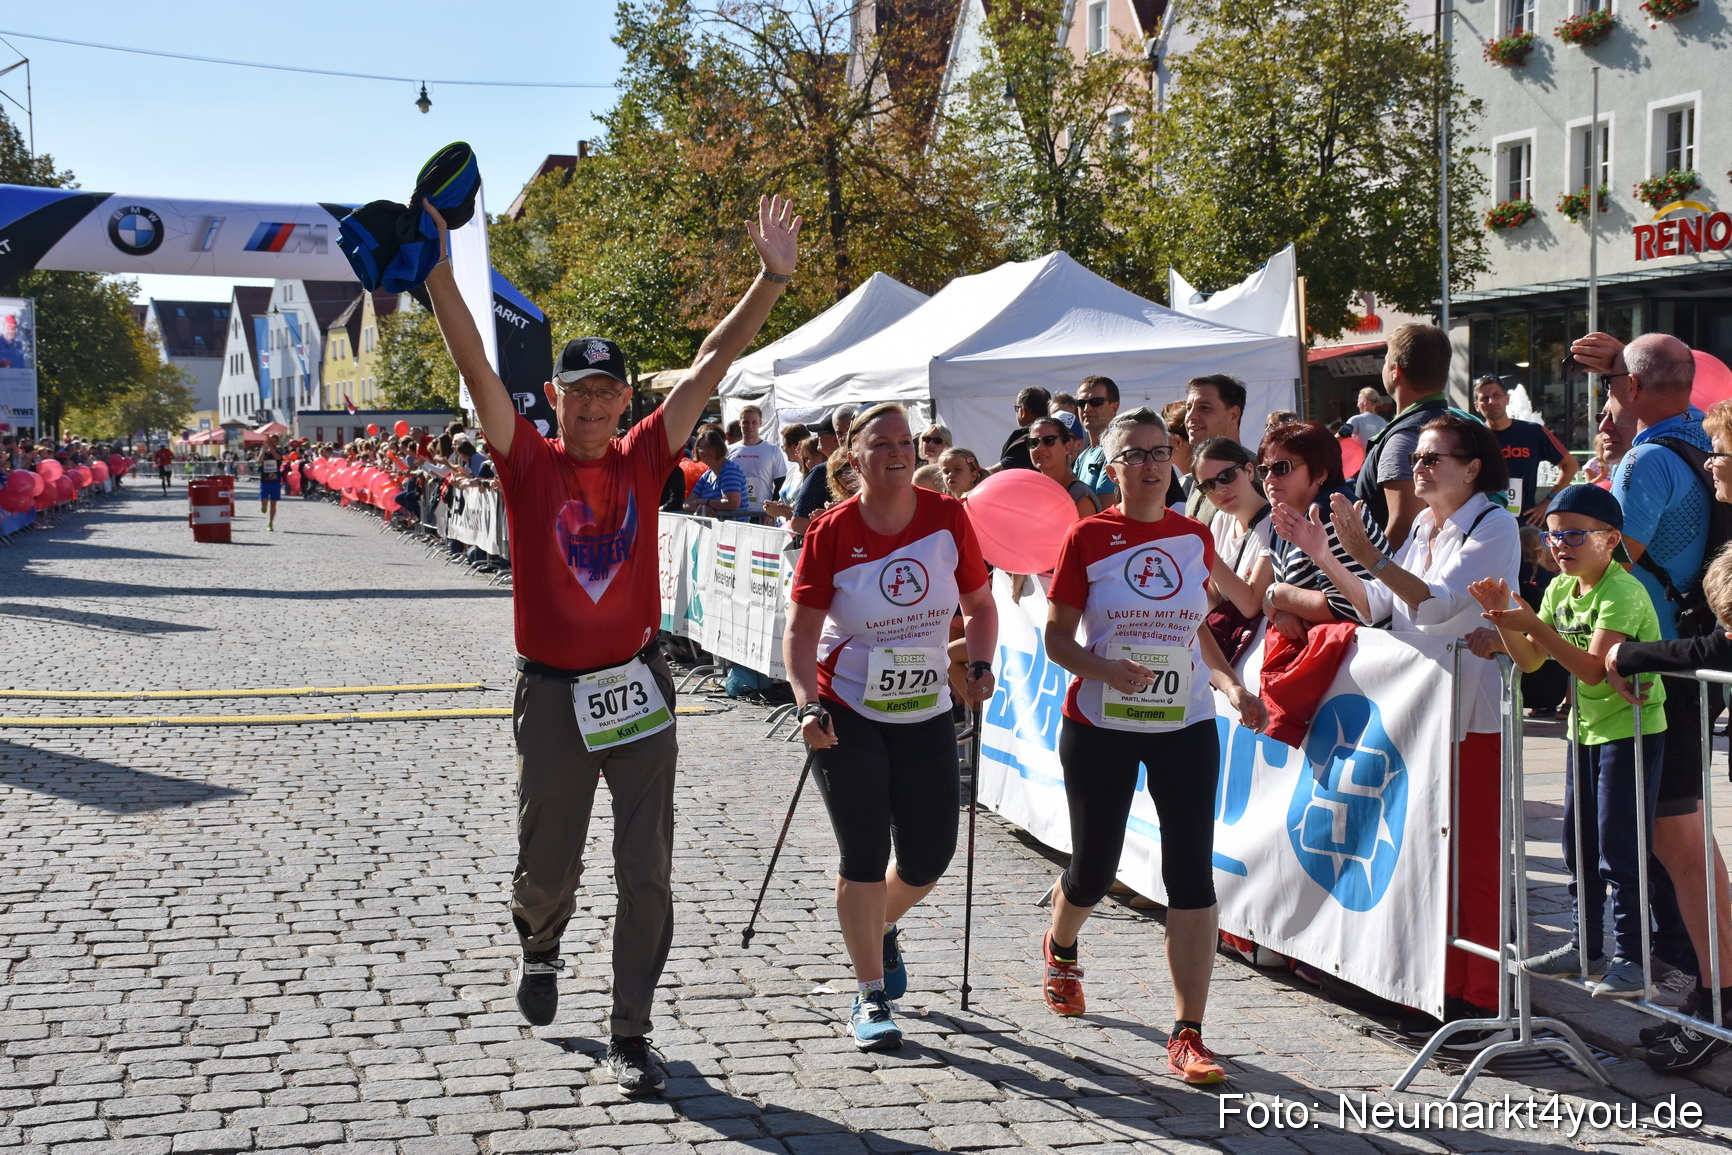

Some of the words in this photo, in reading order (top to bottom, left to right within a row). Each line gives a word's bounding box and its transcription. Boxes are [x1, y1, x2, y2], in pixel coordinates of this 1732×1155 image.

[115, 206, 159, 223] BMW
[1633, 212, 1732, 261] RENO
[493, 301, 530, 329] ARKT
[1501, 445, 1531, 458] das
[1621, 463, 1635, 492] BIONIC
[748, 485, 754, 493] 2
[1508, 489, 1516, 500] 9
[568, 537, 630, 569] HELFER
[589, 568, 609, 581] 2017
[866, 617, 903, 629] LAUFEN
[907, 613, 924, 622] MIT
[928, 608, 950, 618] HERZ
[1107, 609, 1150, 620] LAUFEN
[1155, 610, 1175, 618] MIT
[877, 630, 935, 643] Leistungsdiagno
[888, 627, 904, 635] Heck
[894, 655, 925, 663] BOCK
[1131, 653, 1169, 663] BOCK
[1137, 670, 1180, 695] 70
[588, 681, 648, 719] 5073
[887, 699, 919, 711] Kerstin
[599, 719, 617, 728] PARTL
[618, 711, 642, 723] Neumarkt
[1127, 707, 1165, 719] Carmen
[616, 723, 640, 738] Karl
